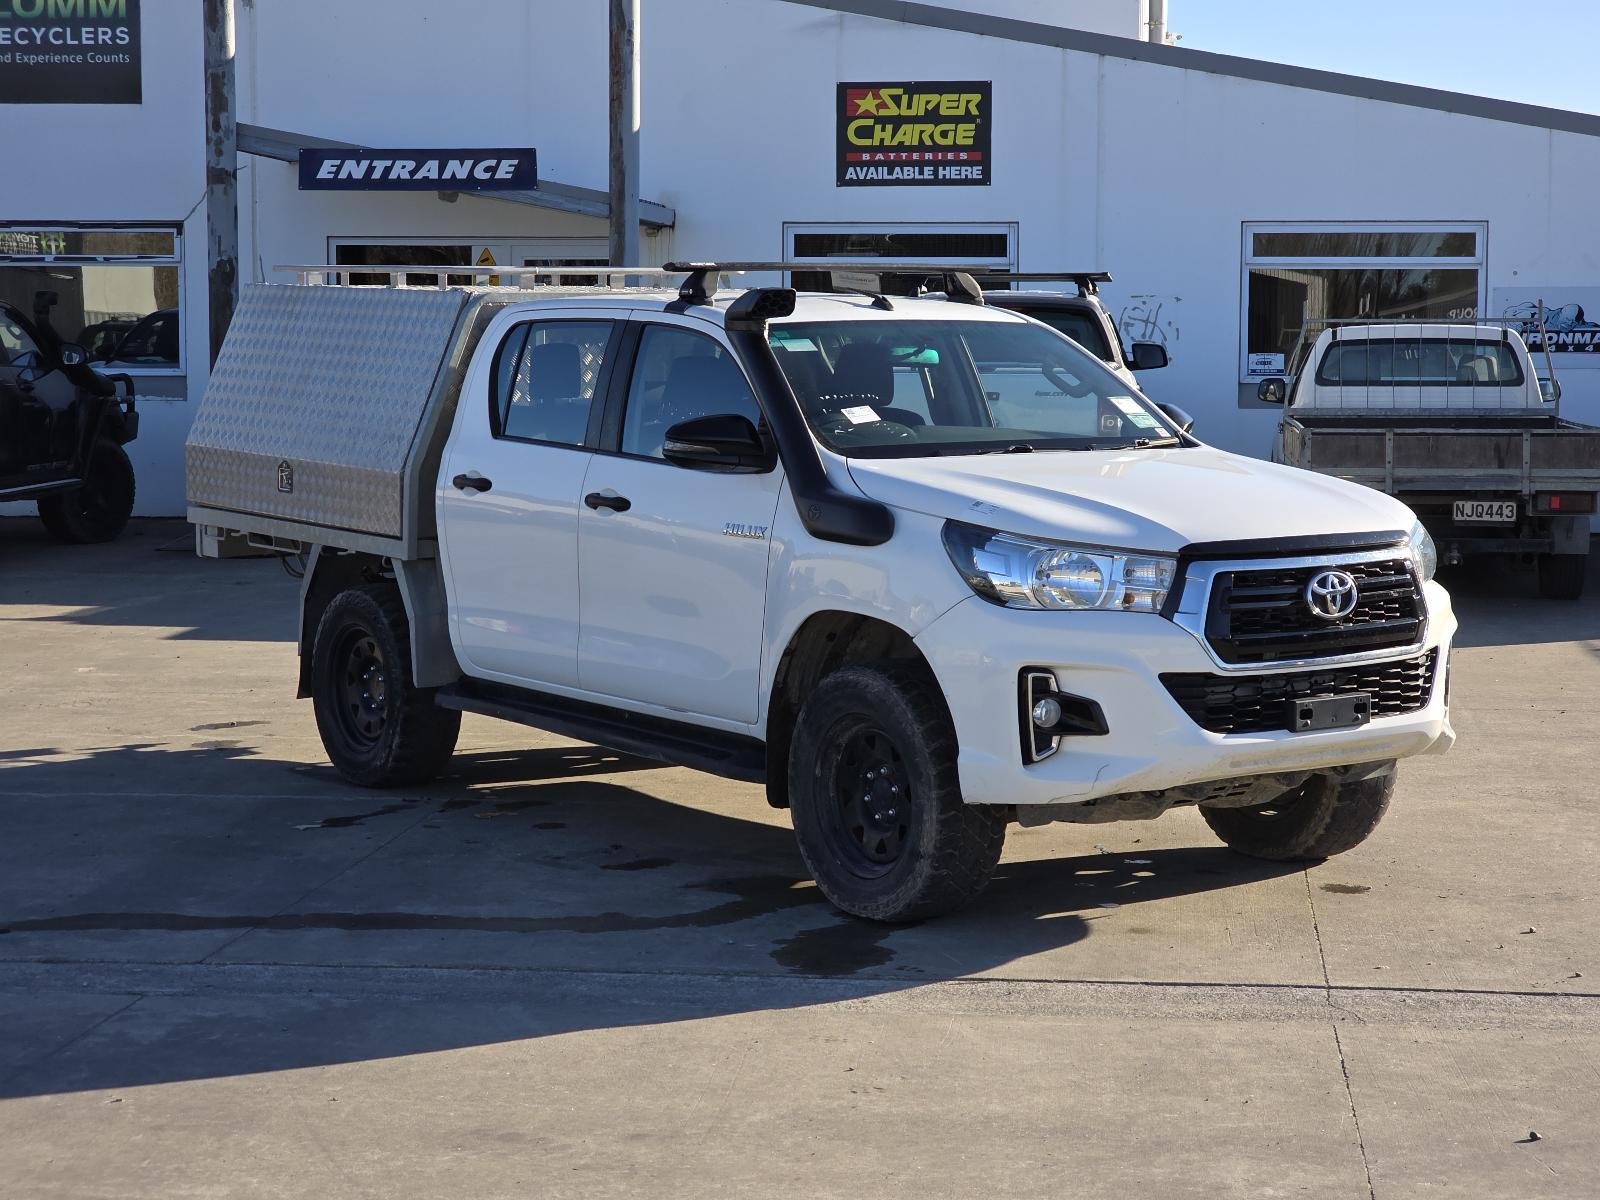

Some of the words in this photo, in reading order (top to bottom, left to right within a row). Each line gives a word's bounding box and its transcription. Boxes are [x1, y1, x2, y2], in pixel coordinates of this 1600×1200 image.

[0, 0, 127, 19] OMM
[15, 53, 83, 65] Experience
[87, 52, 130, 63] Counts
[878, 88, 982, 116] SUPER
[847, 118, 976, 146] CHARGE
[862, 152, 968, 161] BATTERIES
[316, 159, 519, 180] ENTRANCE
[845, 166, 934, 180] AVAILABLE
[938, 166, 983, 179] HERE
[1455, 504, 1515, 519] NJQ443
